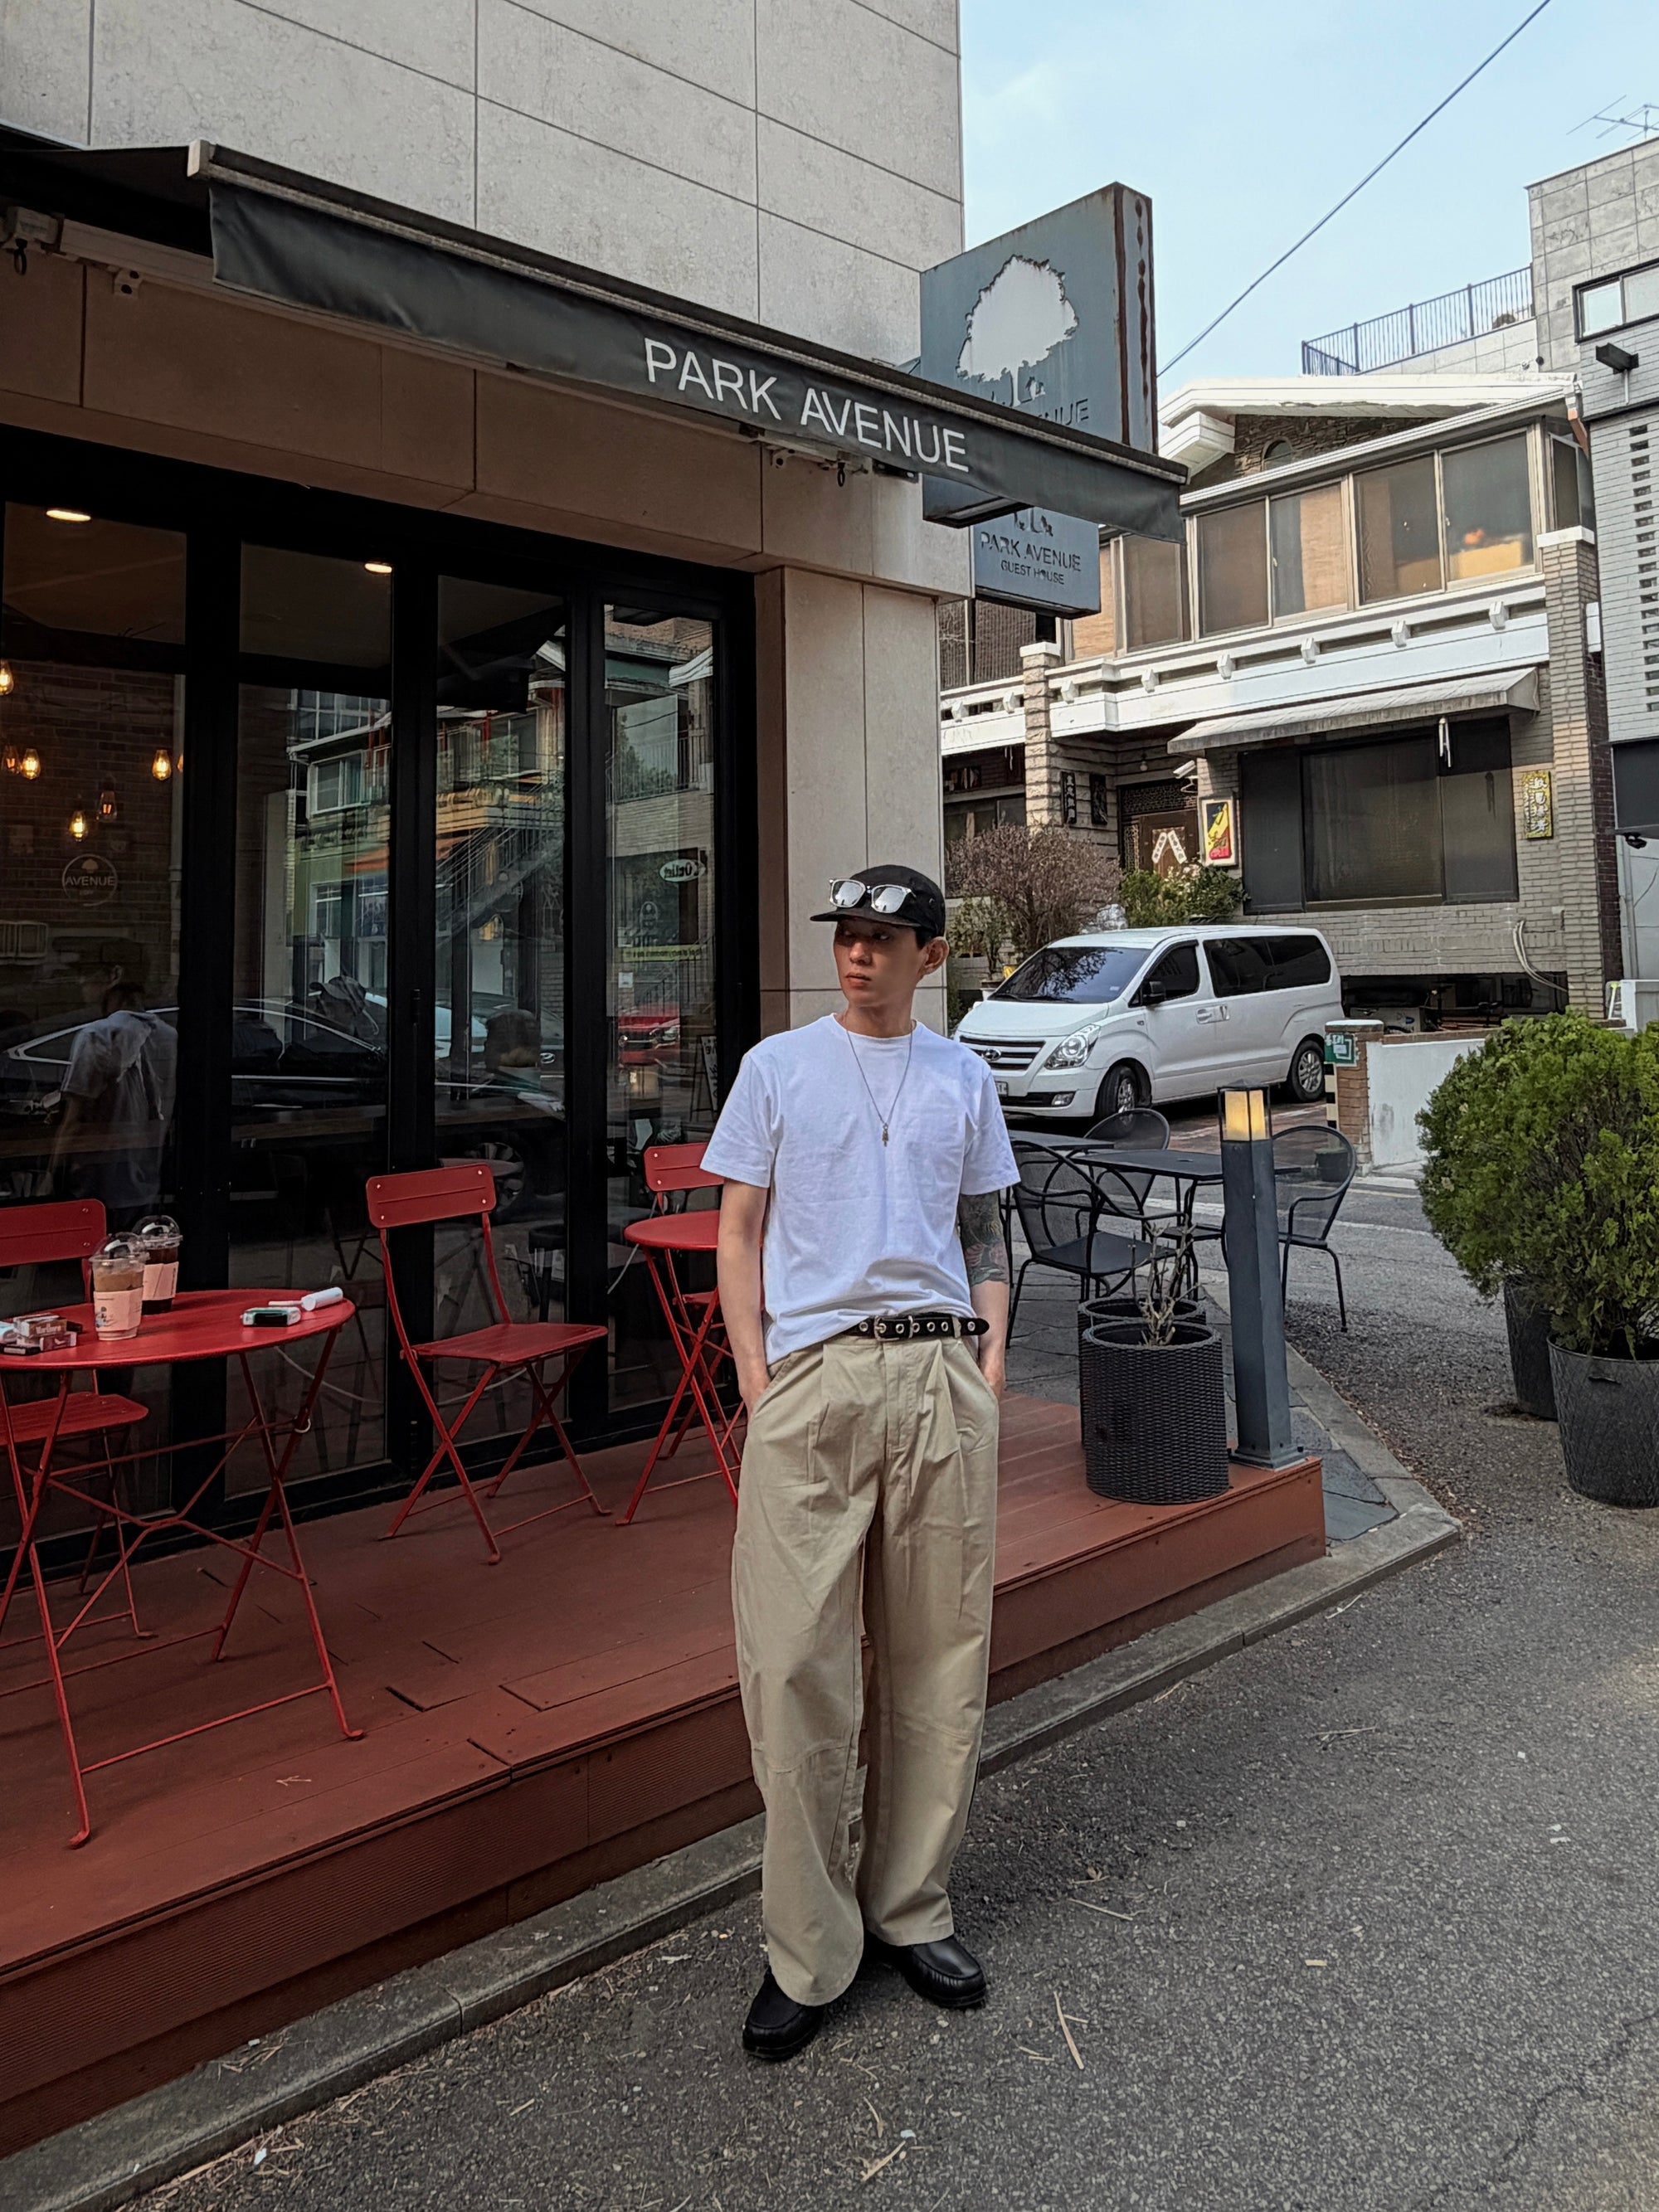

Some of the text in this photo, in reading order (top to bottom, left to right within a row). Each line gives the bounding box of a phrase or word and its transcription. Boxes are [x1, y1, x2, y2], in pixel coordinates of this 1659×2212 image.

[645, 338, 969, 472] PARK AVENUE
[980, 532, 1081, 572] PARK AVENUE
[1000, 560, 1065, 585] GUEST HOUSE
[66, 876, 115, 886] AVENUE
